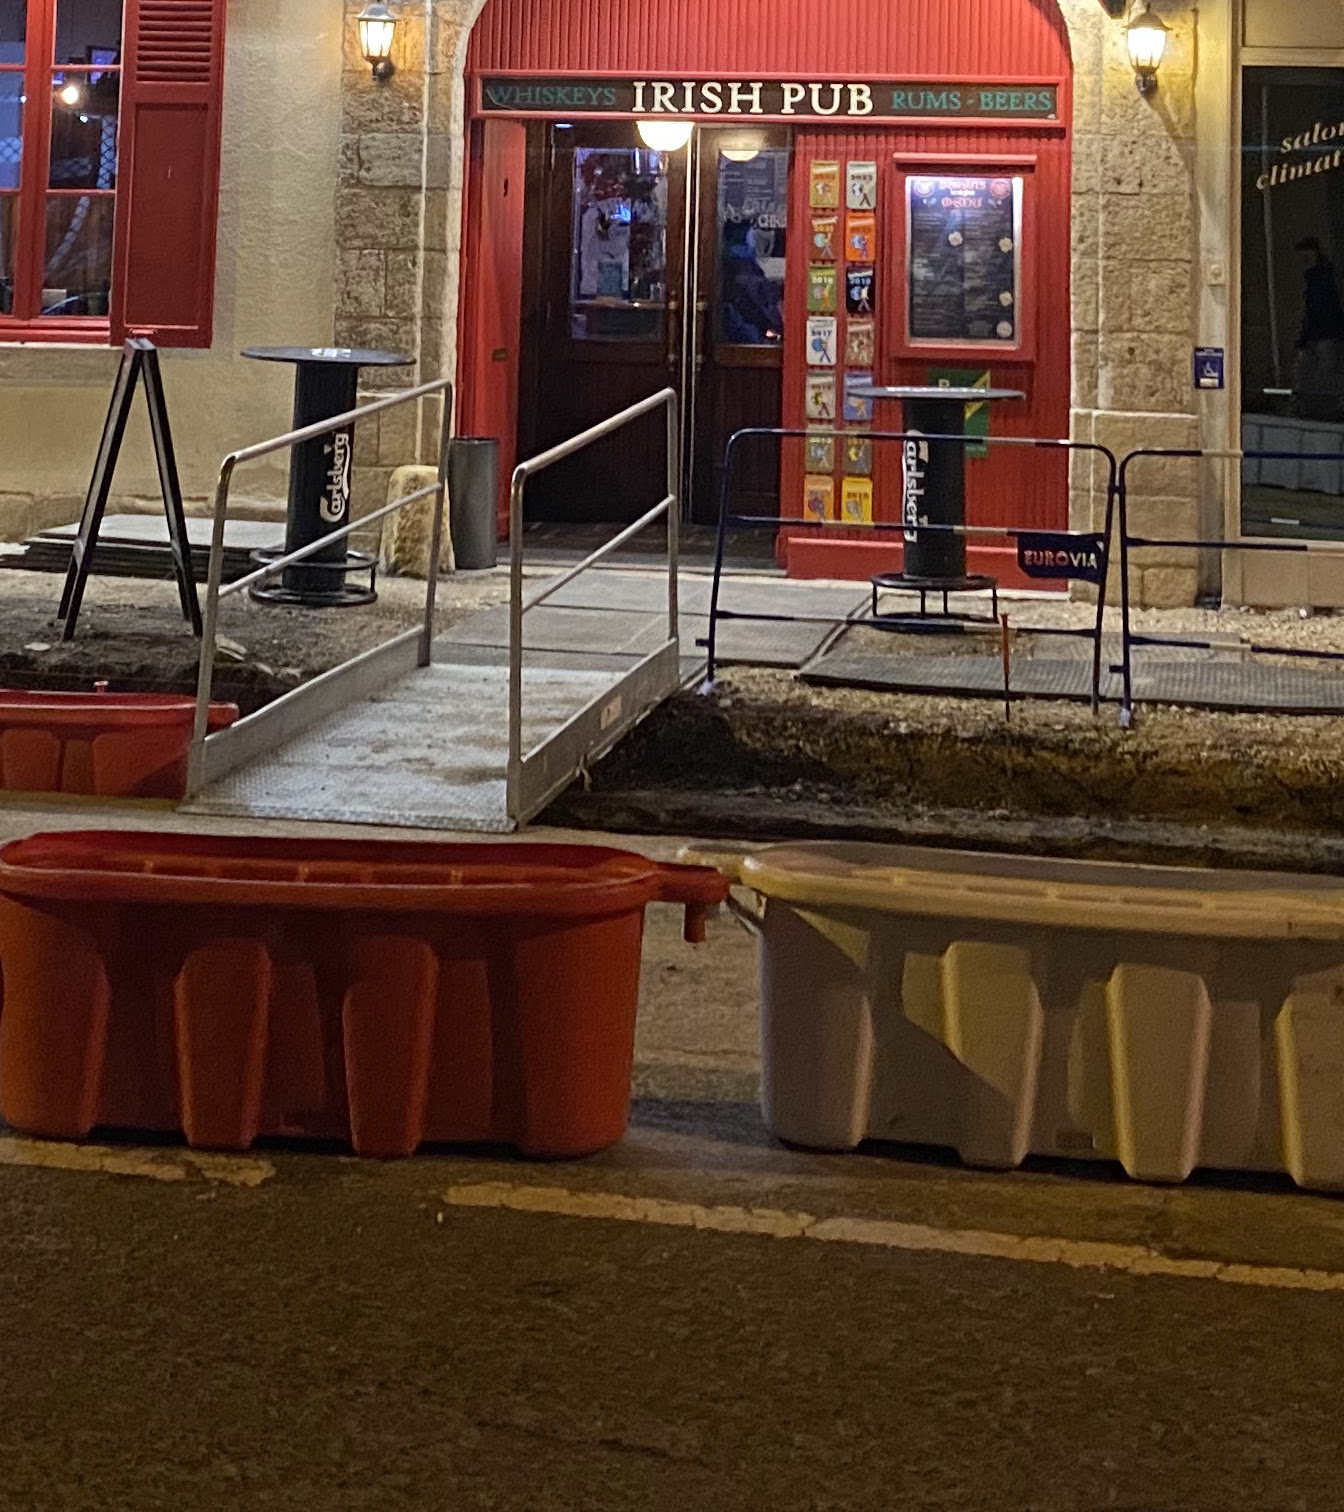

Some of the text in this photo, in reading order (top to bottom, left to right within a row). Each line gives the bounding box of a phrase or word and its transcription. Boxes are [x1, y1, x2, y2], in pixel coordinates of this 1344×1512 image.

[487, 86, 616, 107] WHISKEYS
[631, 81, 765, 114] IRISH
[780, 83, 874, 115] PUB
[891, 91, 961, 111] RUMS
[979, 91, 1052, 111] BEERS
[810, 328, 832, 337] 2017
[319, 432, 350, 522] Carlsberg
[1024, 550, 1098, 569] EUROVIA
